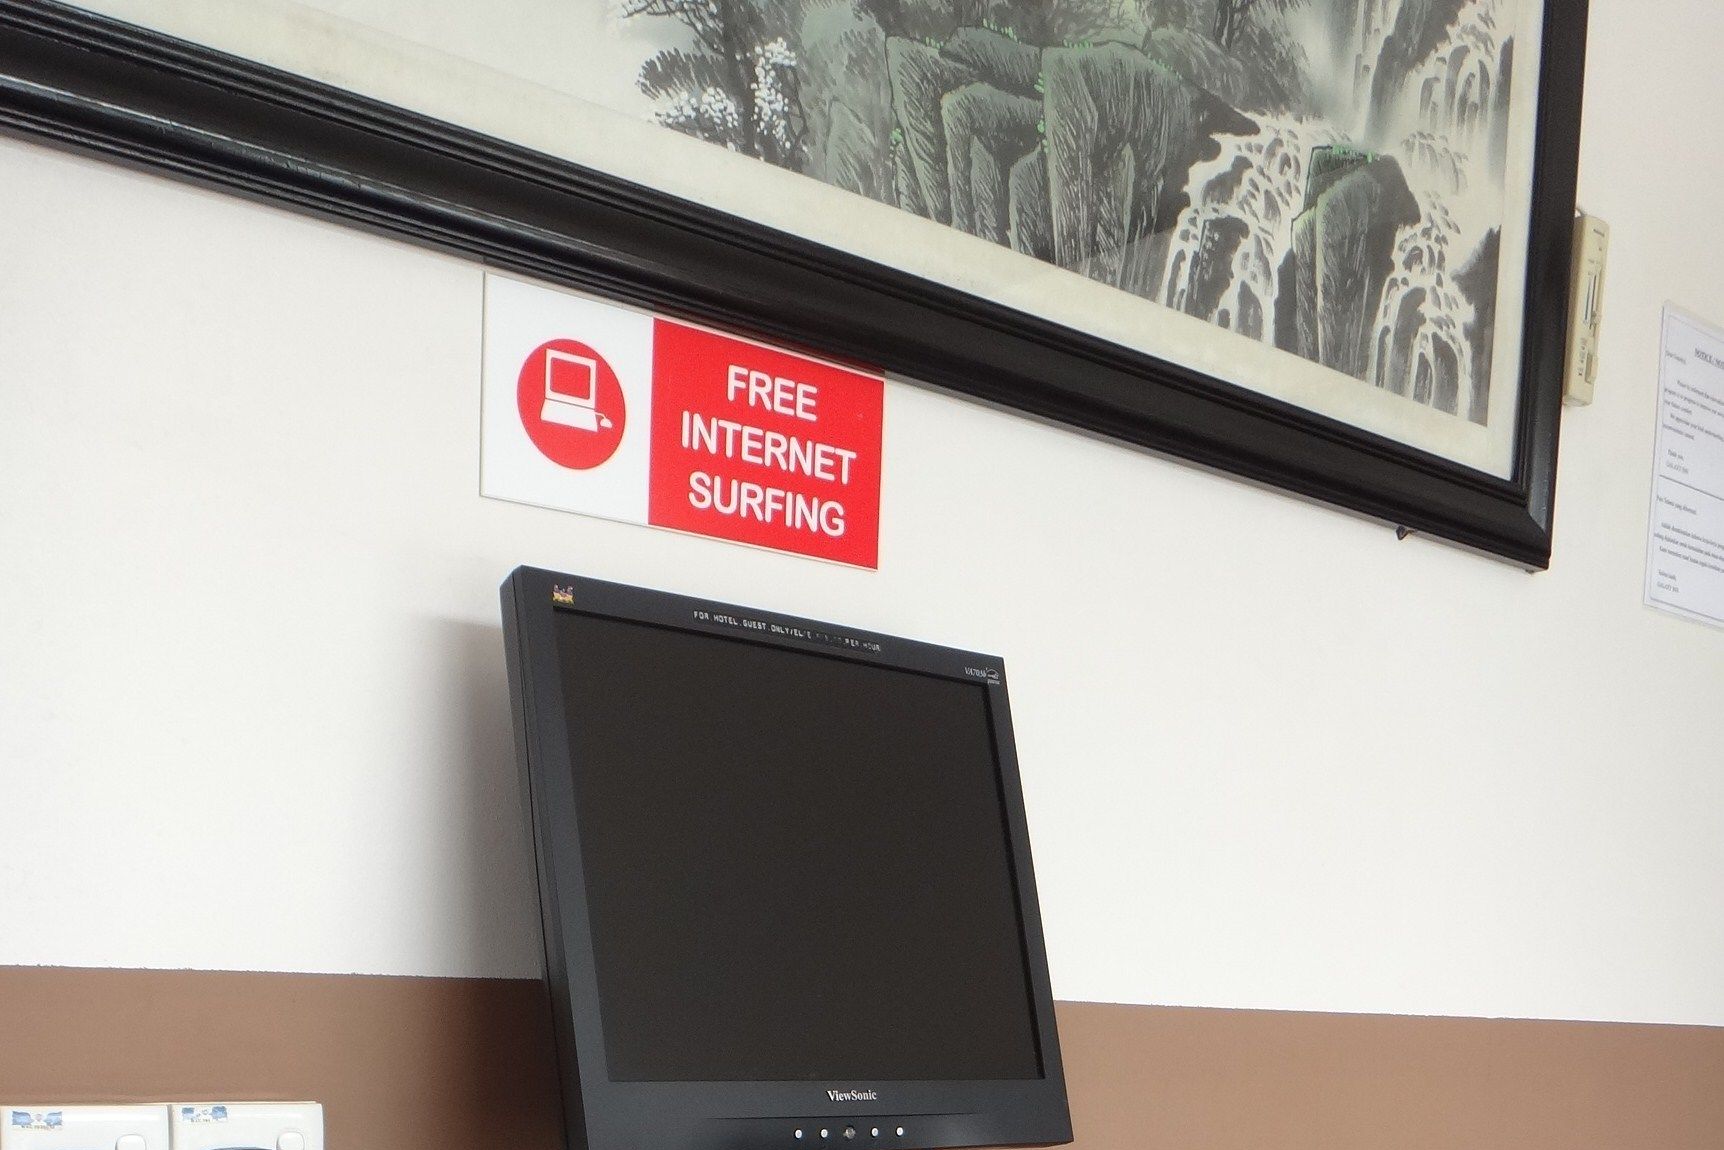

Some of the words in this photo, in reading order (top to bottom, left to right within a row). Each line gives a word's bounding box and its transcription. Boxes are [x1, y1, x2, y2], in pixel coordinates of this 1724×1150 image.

[726, 364, 818, 422] FREE
[681, 410, 857, 485] INTERNET
[688, 471, 845, 538] SURFING
[693, 610, 709, 620] FOR
[713, 614, 738, 626] HOTEL
[742, 619, 767, 631] GUEST
[827, 1089, 877, 1102] ViewSonic
